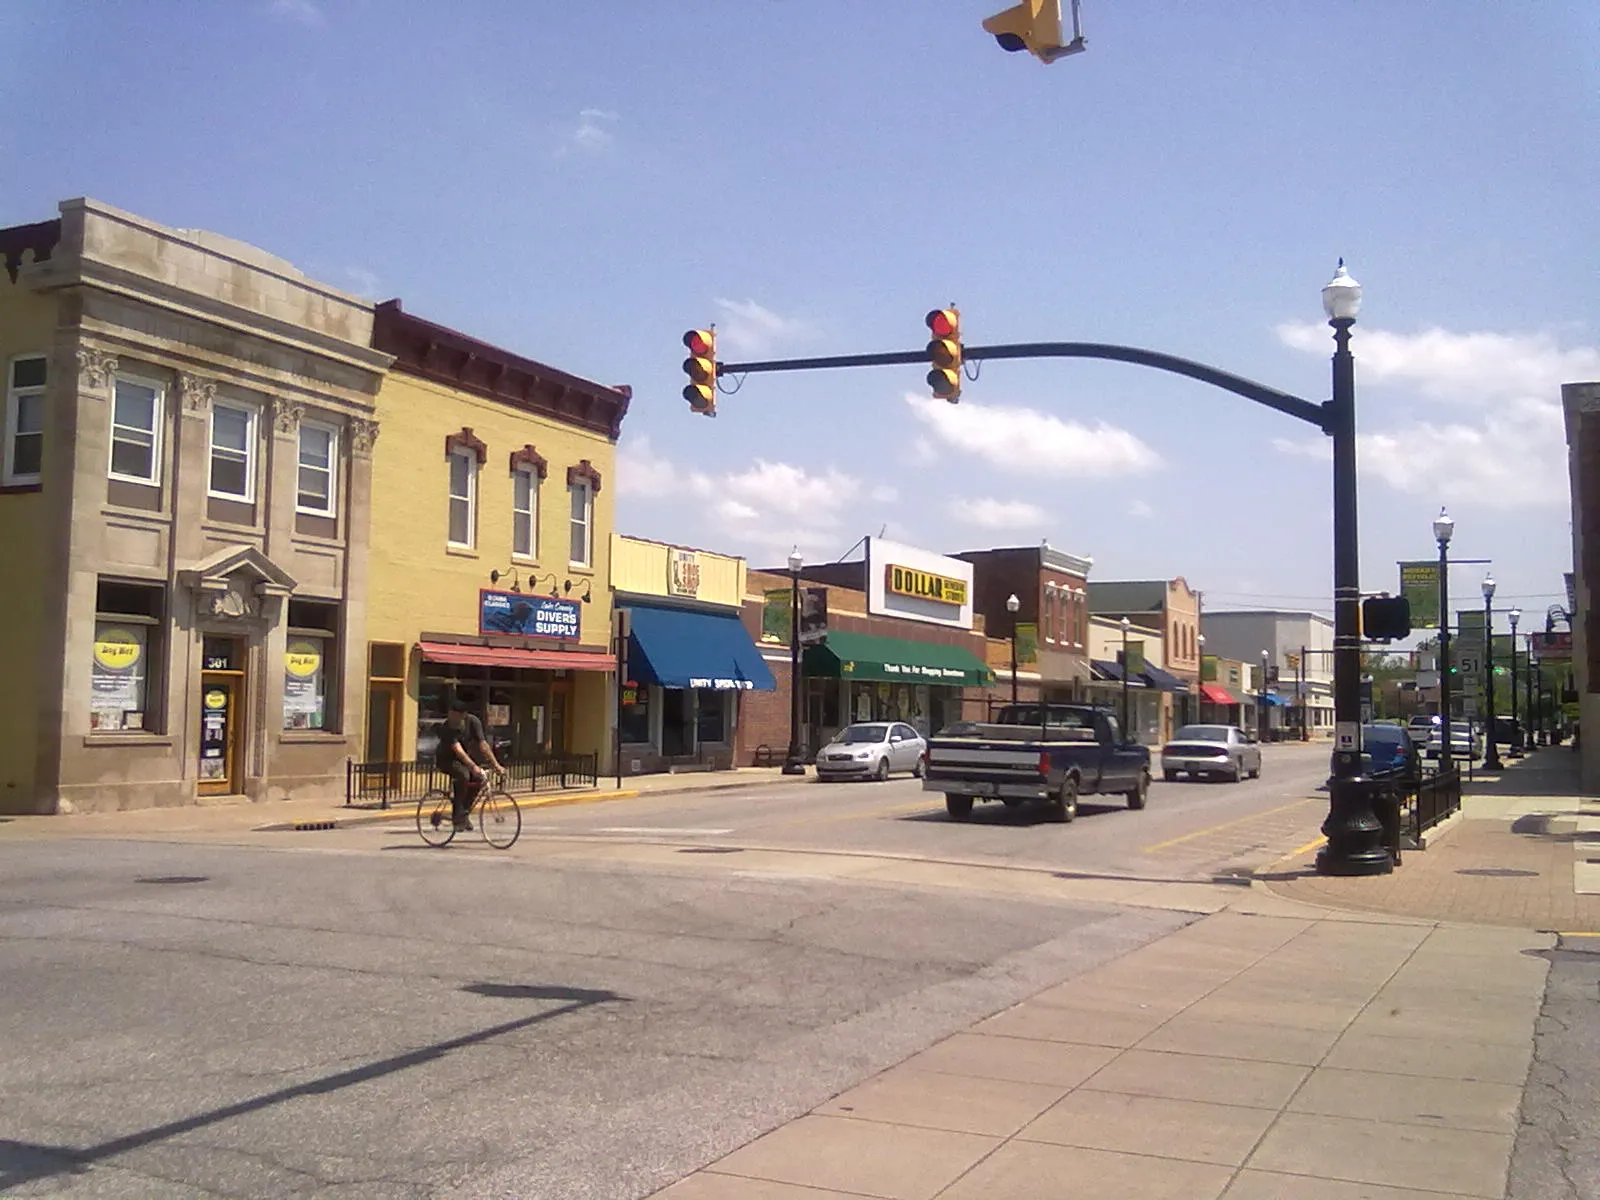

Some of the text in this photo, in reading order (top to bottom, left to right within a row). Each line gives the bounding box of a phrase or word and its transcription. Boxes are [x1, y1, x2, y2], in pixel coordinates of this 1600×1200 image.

[894, 568, 943, 598] DOLLAR
[536, 610, 577, 624] DIVERS
[535, 622, 578, 635] SUPPLY
[208, 658, 228, 668] 301
[1462, 659, 1478, 672] 51
[689, 678, 712, 688] UNITY
